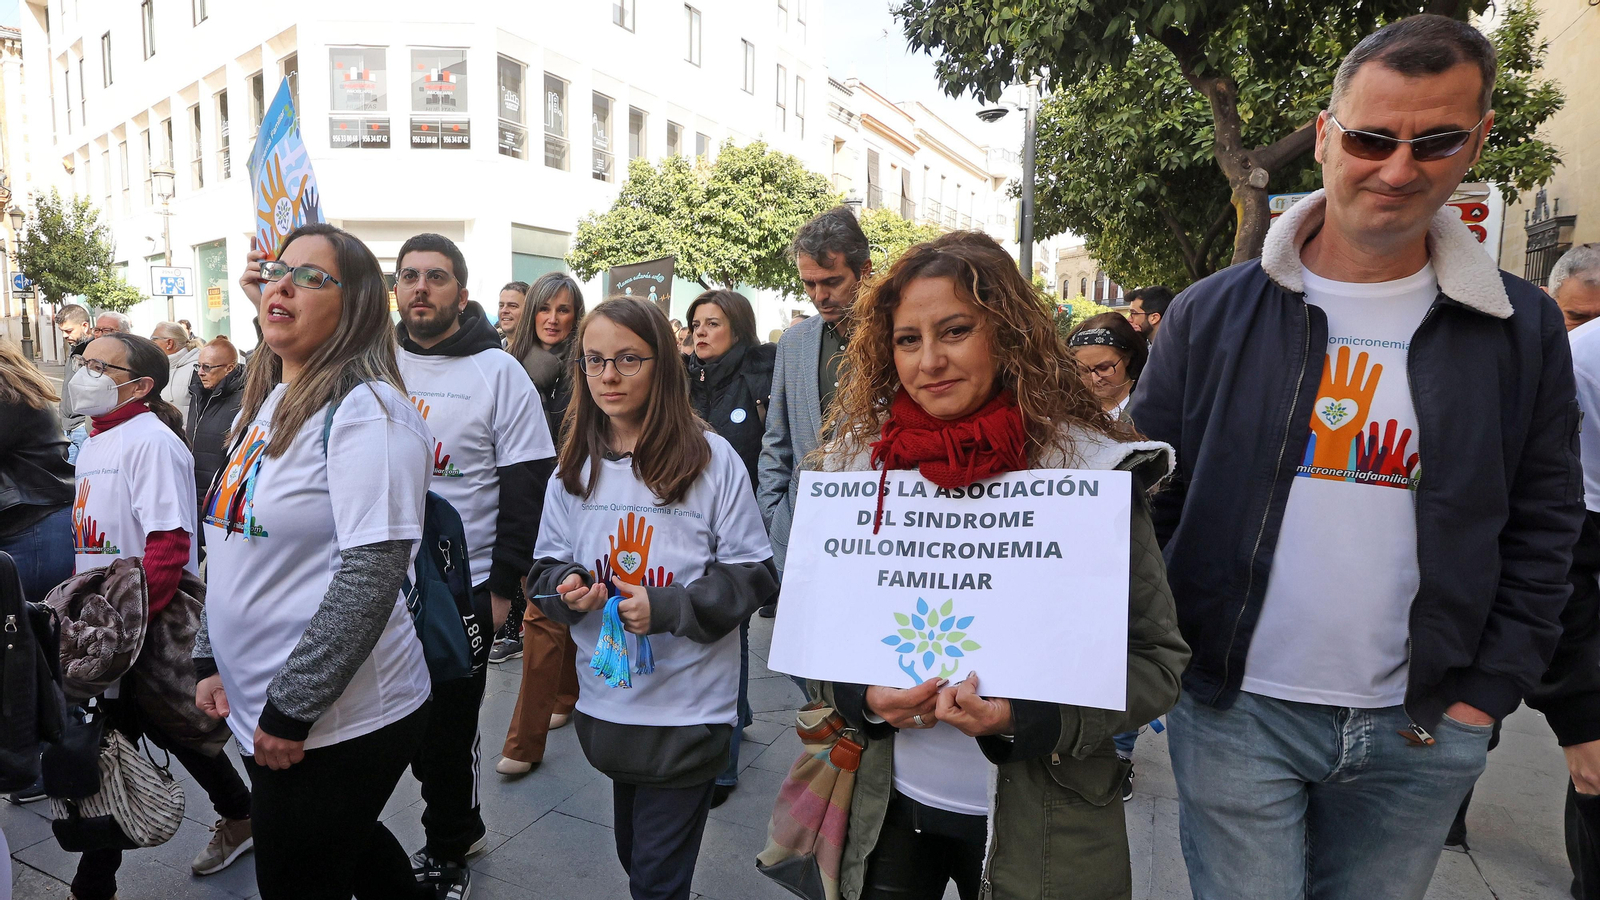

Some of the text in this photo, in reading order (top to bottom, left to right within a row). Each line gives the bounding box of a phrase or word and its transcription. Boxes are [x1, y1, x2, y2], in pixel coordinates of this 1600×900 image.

[446, 392, 472, 400] Familiar
[811, 475, 1100, 500] SOMOS LA ASOCIACIÓN
[903, 511, 1035, 529] SINDROME
[824, 538, 1063, 560] QUILOMICRONEMIA
[877, 569, 993, 590] FAMILIAR
[462, 613, 484, 657] 1987
